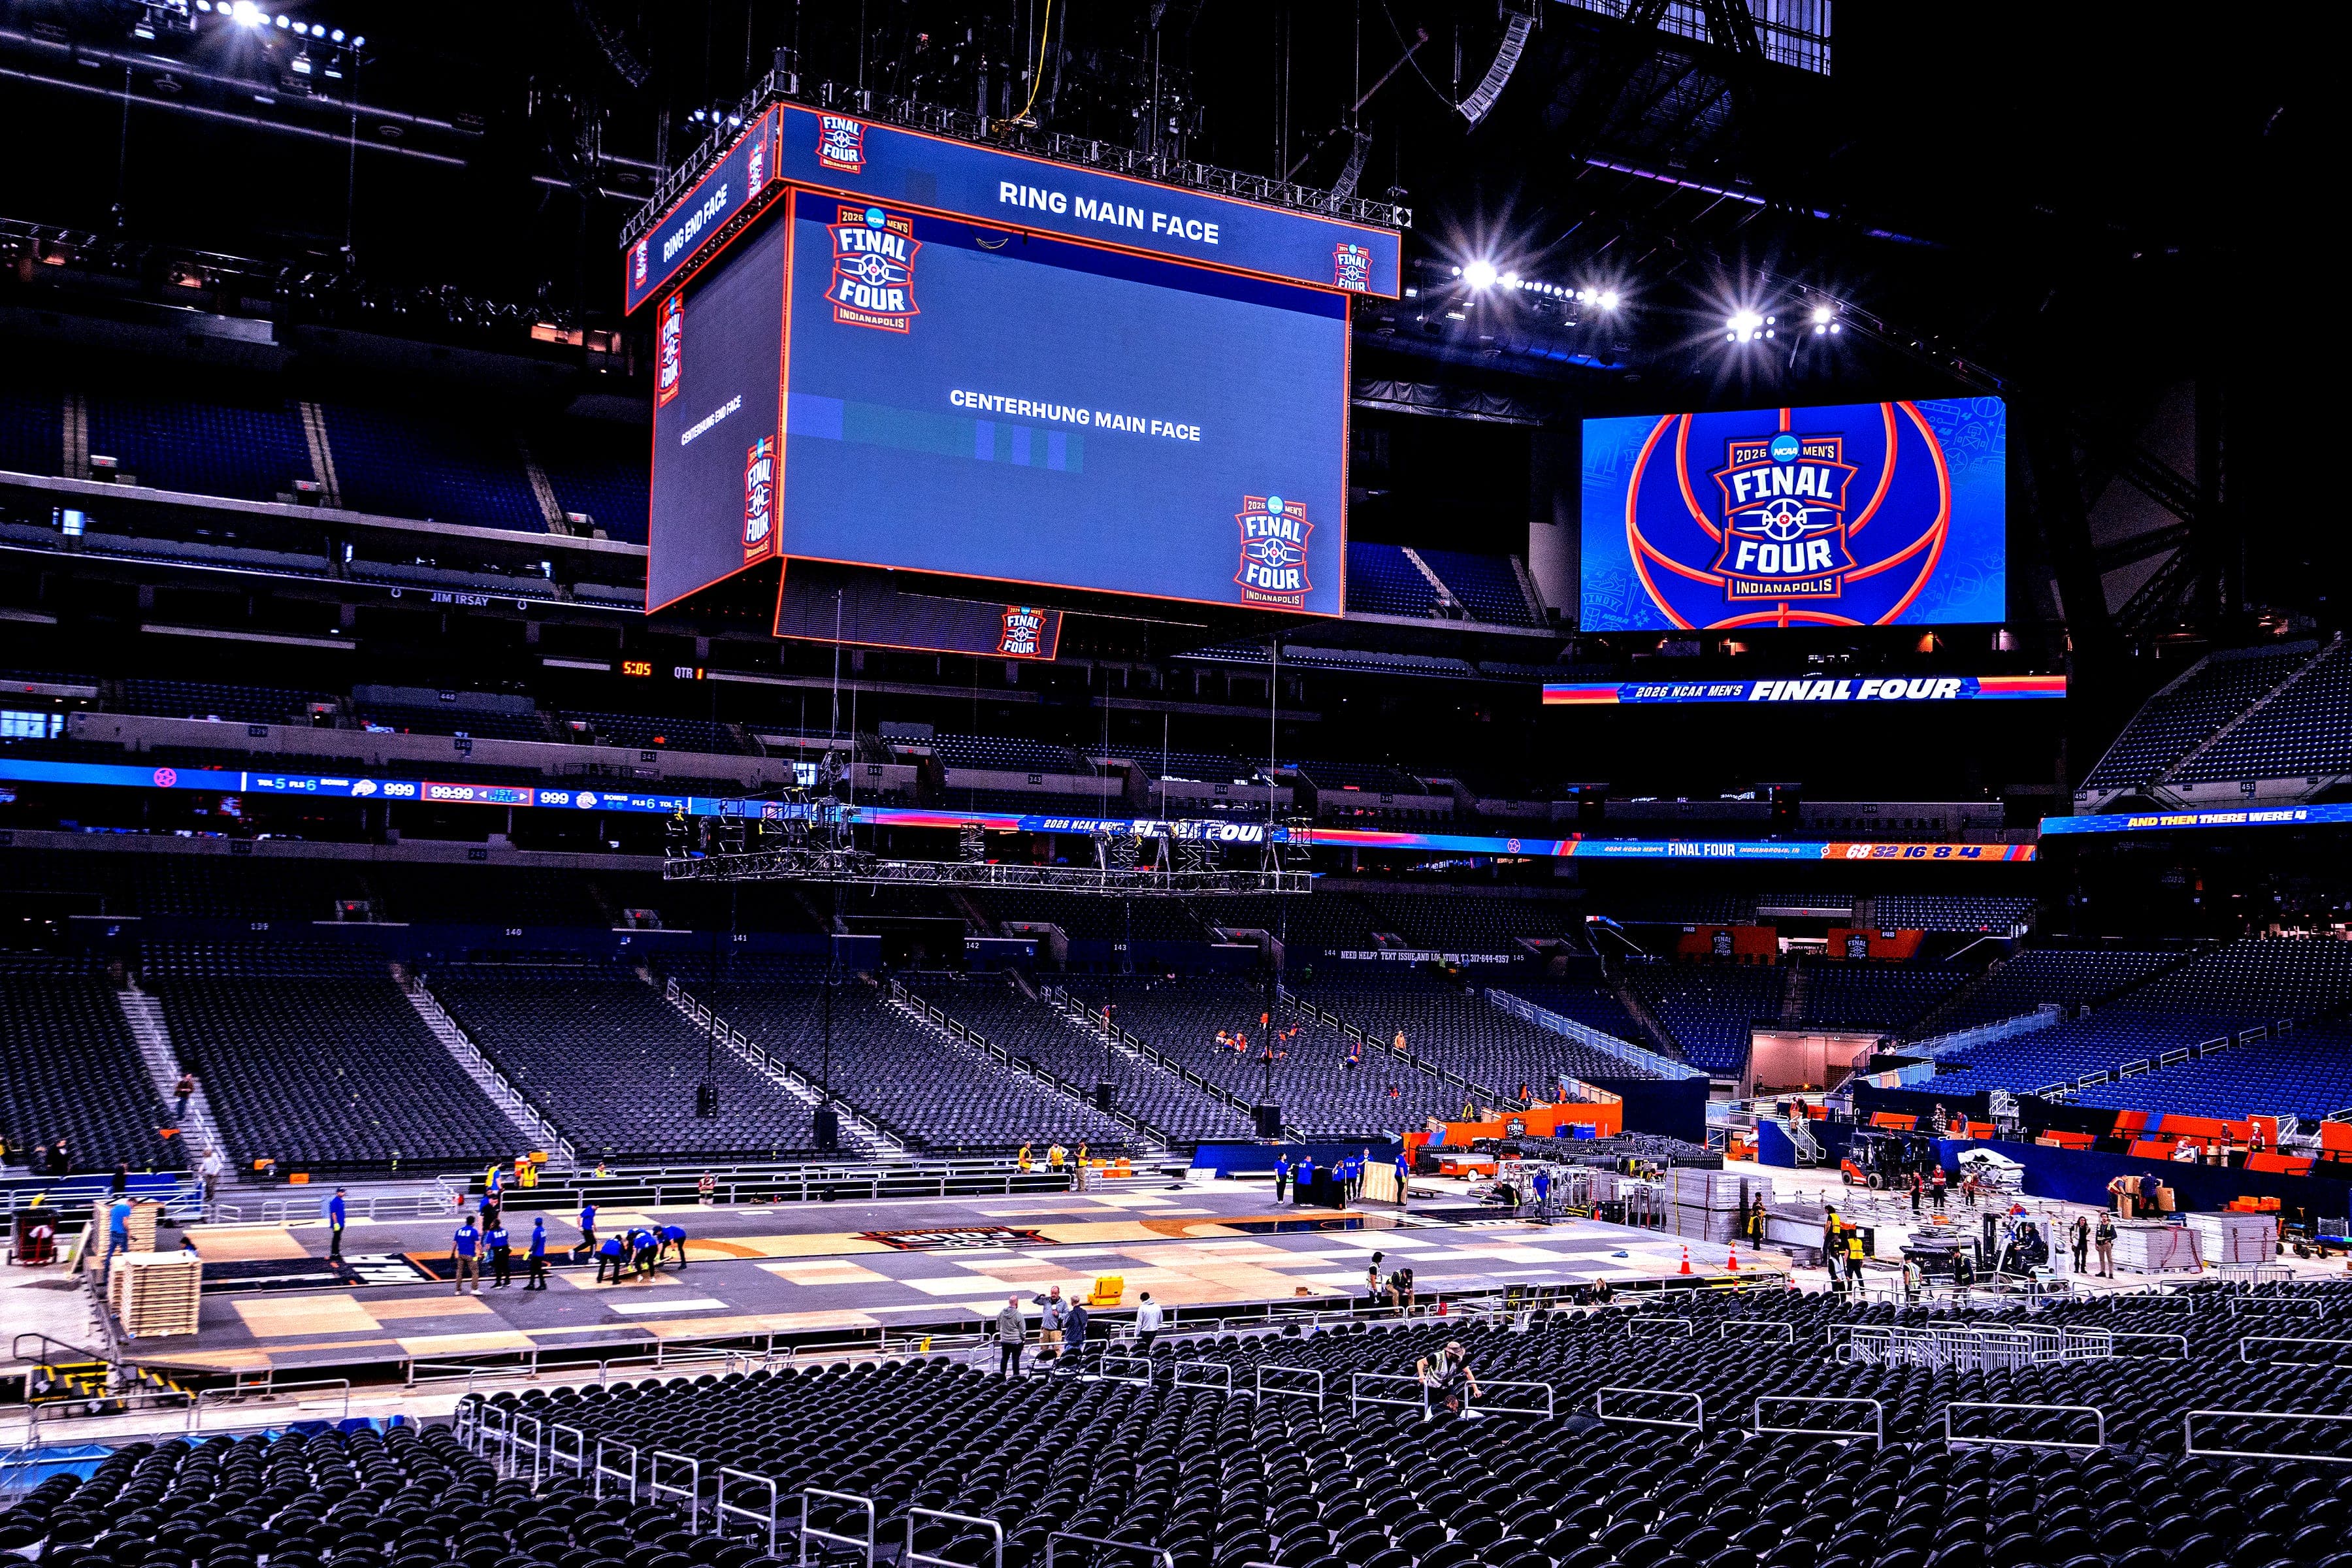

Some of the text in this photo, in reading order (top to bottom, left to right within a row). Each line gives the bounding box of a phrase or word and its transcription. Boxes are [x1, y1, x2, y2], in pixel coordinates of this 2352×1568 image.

[823, 116, 860, 136] FINAL
[823, 142, 858, 162] FOUR
[1000, 181, 1220, 245] RING MAIN FACE
[663, 227, 684, 263] RING
[685, 210, 703, 243] END
[704, 184, 728, 224] FACE
[842, 211, 864, 221] 2026
[887, 220, 908, 233] MEN'S
[839, 229, 907, 262] FINAL
[1337, 254, 1367, 269] FINAL
[839, 278, 906, 312] FOUR
[840, 308, 904, 328] INDIANAPOLIS
[681, 395, 742, 446] CENTERHUNG END FACE
[950, 389, 1201, 442] CENTERHUNG MAIN FACE
[1737, 445, 1835, 463] 2026 NCAA MEN'S
[747, 459, 771, 492] FINAL
[1733, 466, 1833, 503] FINAL
[1248, 500, 1266, 510] 2026
[1284, 506, 1302, 516] MEN'S
[746, 511, 769, 542] FOUR
[1245, 515, 1301, 544] FINAL
[1735, 538, 1833, 574] FOUR
[1246, 563, 1301, 590] FOUR
[1737, 578, 1833, 594] INDIANAPOLIS
[431, 593, 489, 606] JIM IRSAY
[1246, 589, 1299, 604] INDIANAPOLIS
[1589, 595, 1618, 608] INDY
[1007, 615, 1039, 629] FINAL
[1003, 639, 1034, 653] FOUR
[623, 661, 651, 676] 5:05
[674, 666, 703, 679] QTR 1
[1635, 686, 1667, 698] 2026
[1708, 685, 1744, 696] MEN'S
[1748, 679, 1852, 702] FINAL
[1855, 678, 1961, 700] FOUR
[275, 777, 286, 789] 5
[306, 779, 317, 791] 6
[384, 783, 416, 796] 999
[2241, 782, 2255, 791] 451
[431, 785, 474, 800] 99:99
[540, 791, 570, 804] 999
[646, 798, 656, 809] 6
[1043, 819, 1070, 829] 2026
[2127, 810, 2307, 828] AND THEN THERE WERE 4
[1668, 843, 1701, 856] FINAL
[1704, 843, 1736, 857] FOUR
[1846, 845, 1982, 859] 68 32 16 8 4
[1341, 951, 1357, 959] NEED
[1359, 951, 1378, 960] HELP?
[1380, 951, 1397, 960] TEXT
[1398, 952, 1416, 961] ISSUE
[1416, 953, 1429, 961] AND
[889, 1231, 1016, 1243] FOUR
